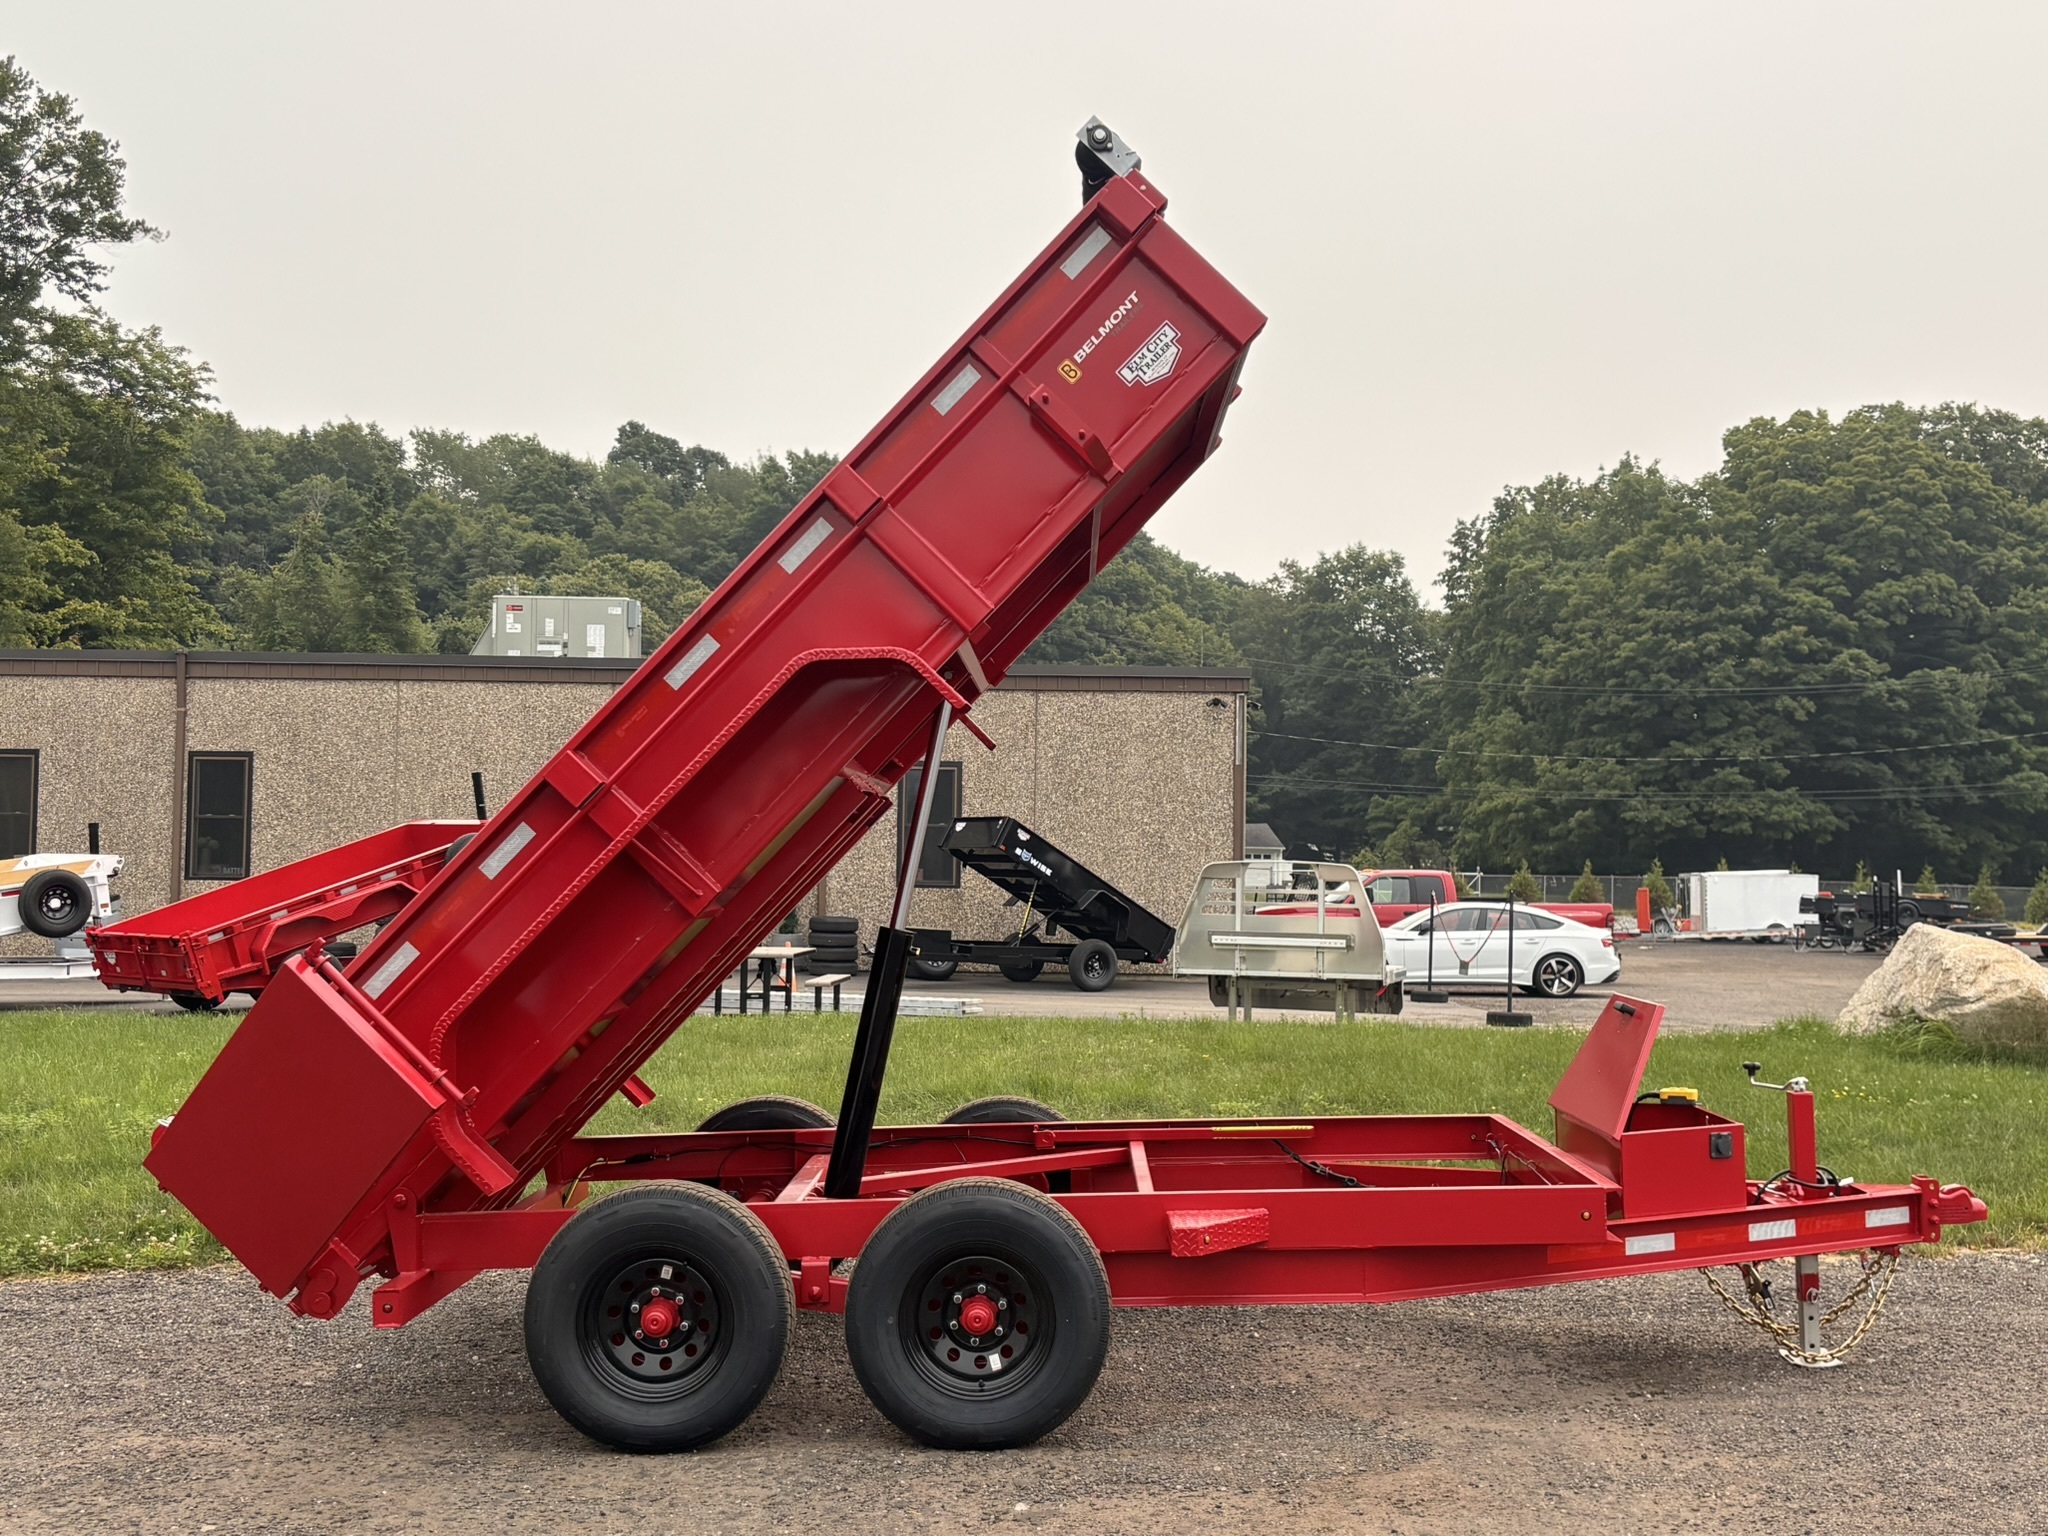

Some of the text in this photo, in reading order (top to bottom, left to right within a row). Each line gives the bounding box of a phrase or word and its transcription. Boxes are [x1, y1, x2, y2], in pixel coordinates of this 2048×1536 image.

[1073, 290, 1139, 363] BELMONT
[1126, 352, 1148, 374] ELM
[1146, 329, 1168, 354] CITY
[1137, 342, 1172, 376] TRAILER
